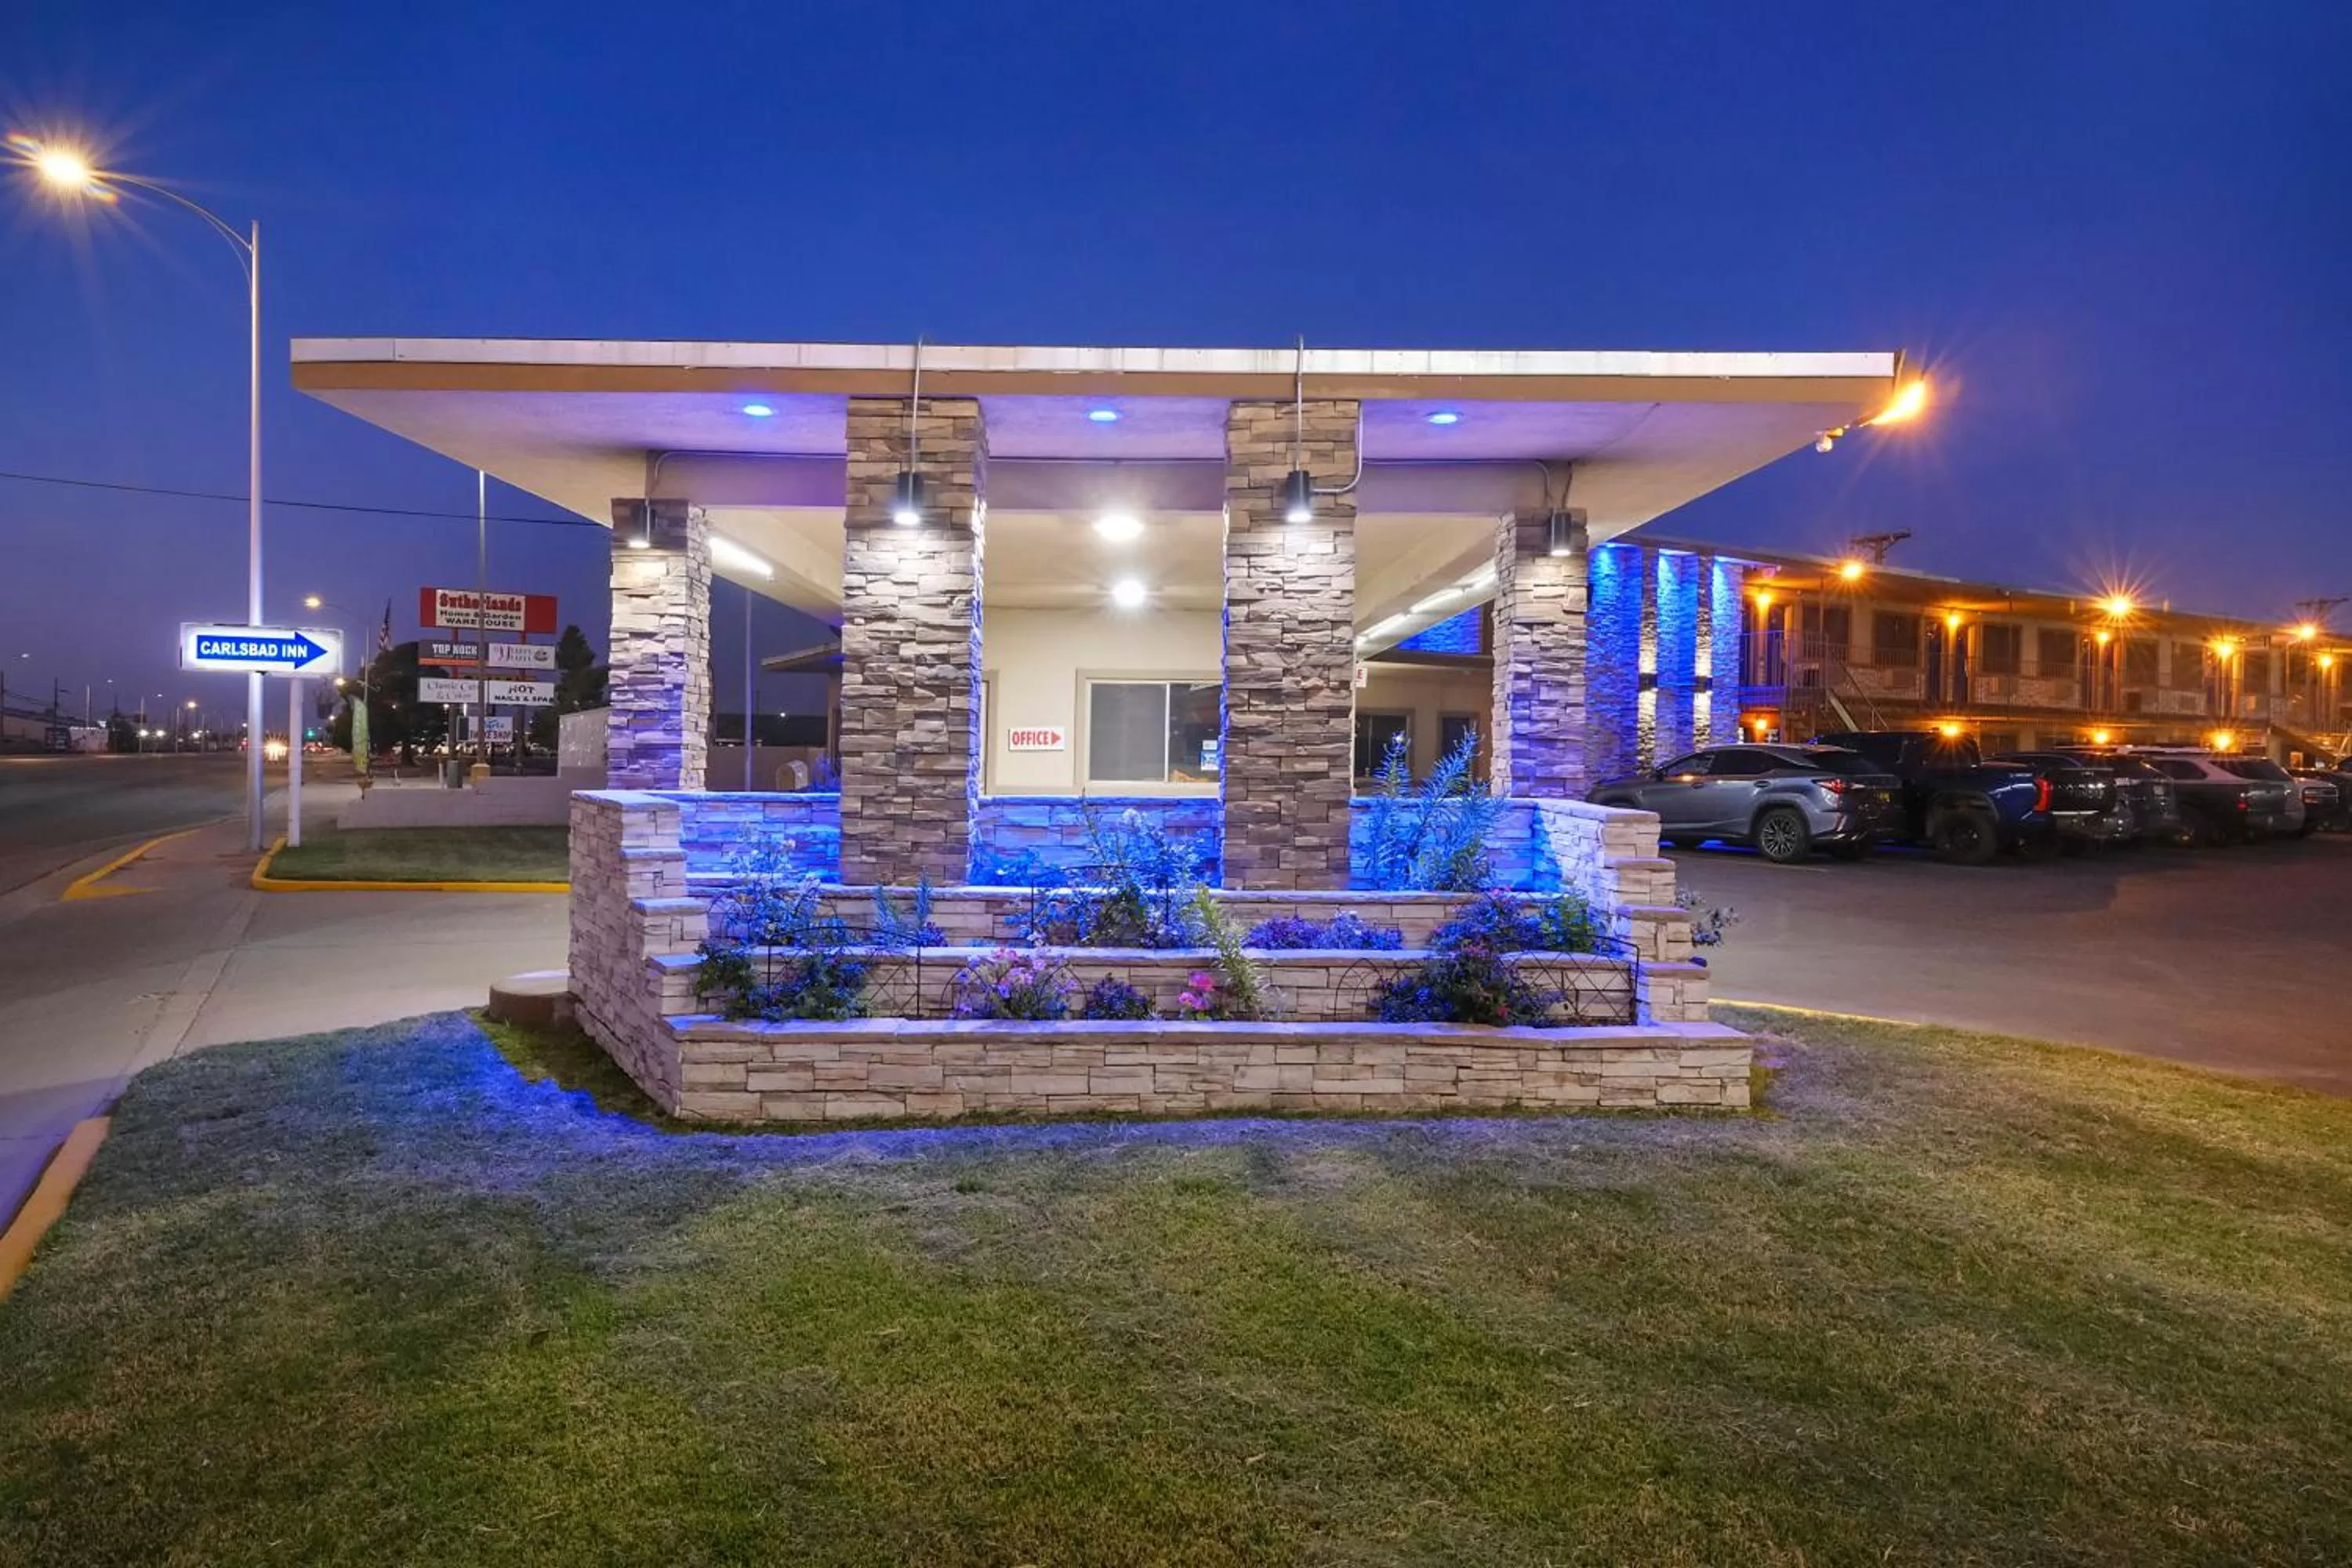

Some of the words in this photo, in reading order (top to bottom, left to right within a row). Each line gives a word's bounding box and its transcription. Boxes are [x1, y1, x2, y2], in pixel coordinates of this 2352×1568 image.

[439, 593, 522, 612] Suthelands
[445, 618, 516, 627] WAREOUSE
[200, 641, 278, 656] CARLSBAD
[281, 644, 307, 658] INN
[432, 643, 448, 655] TOP
[509, 684, 535, 695] HOT
[1012, 730, 1049, 746] OFFICE
